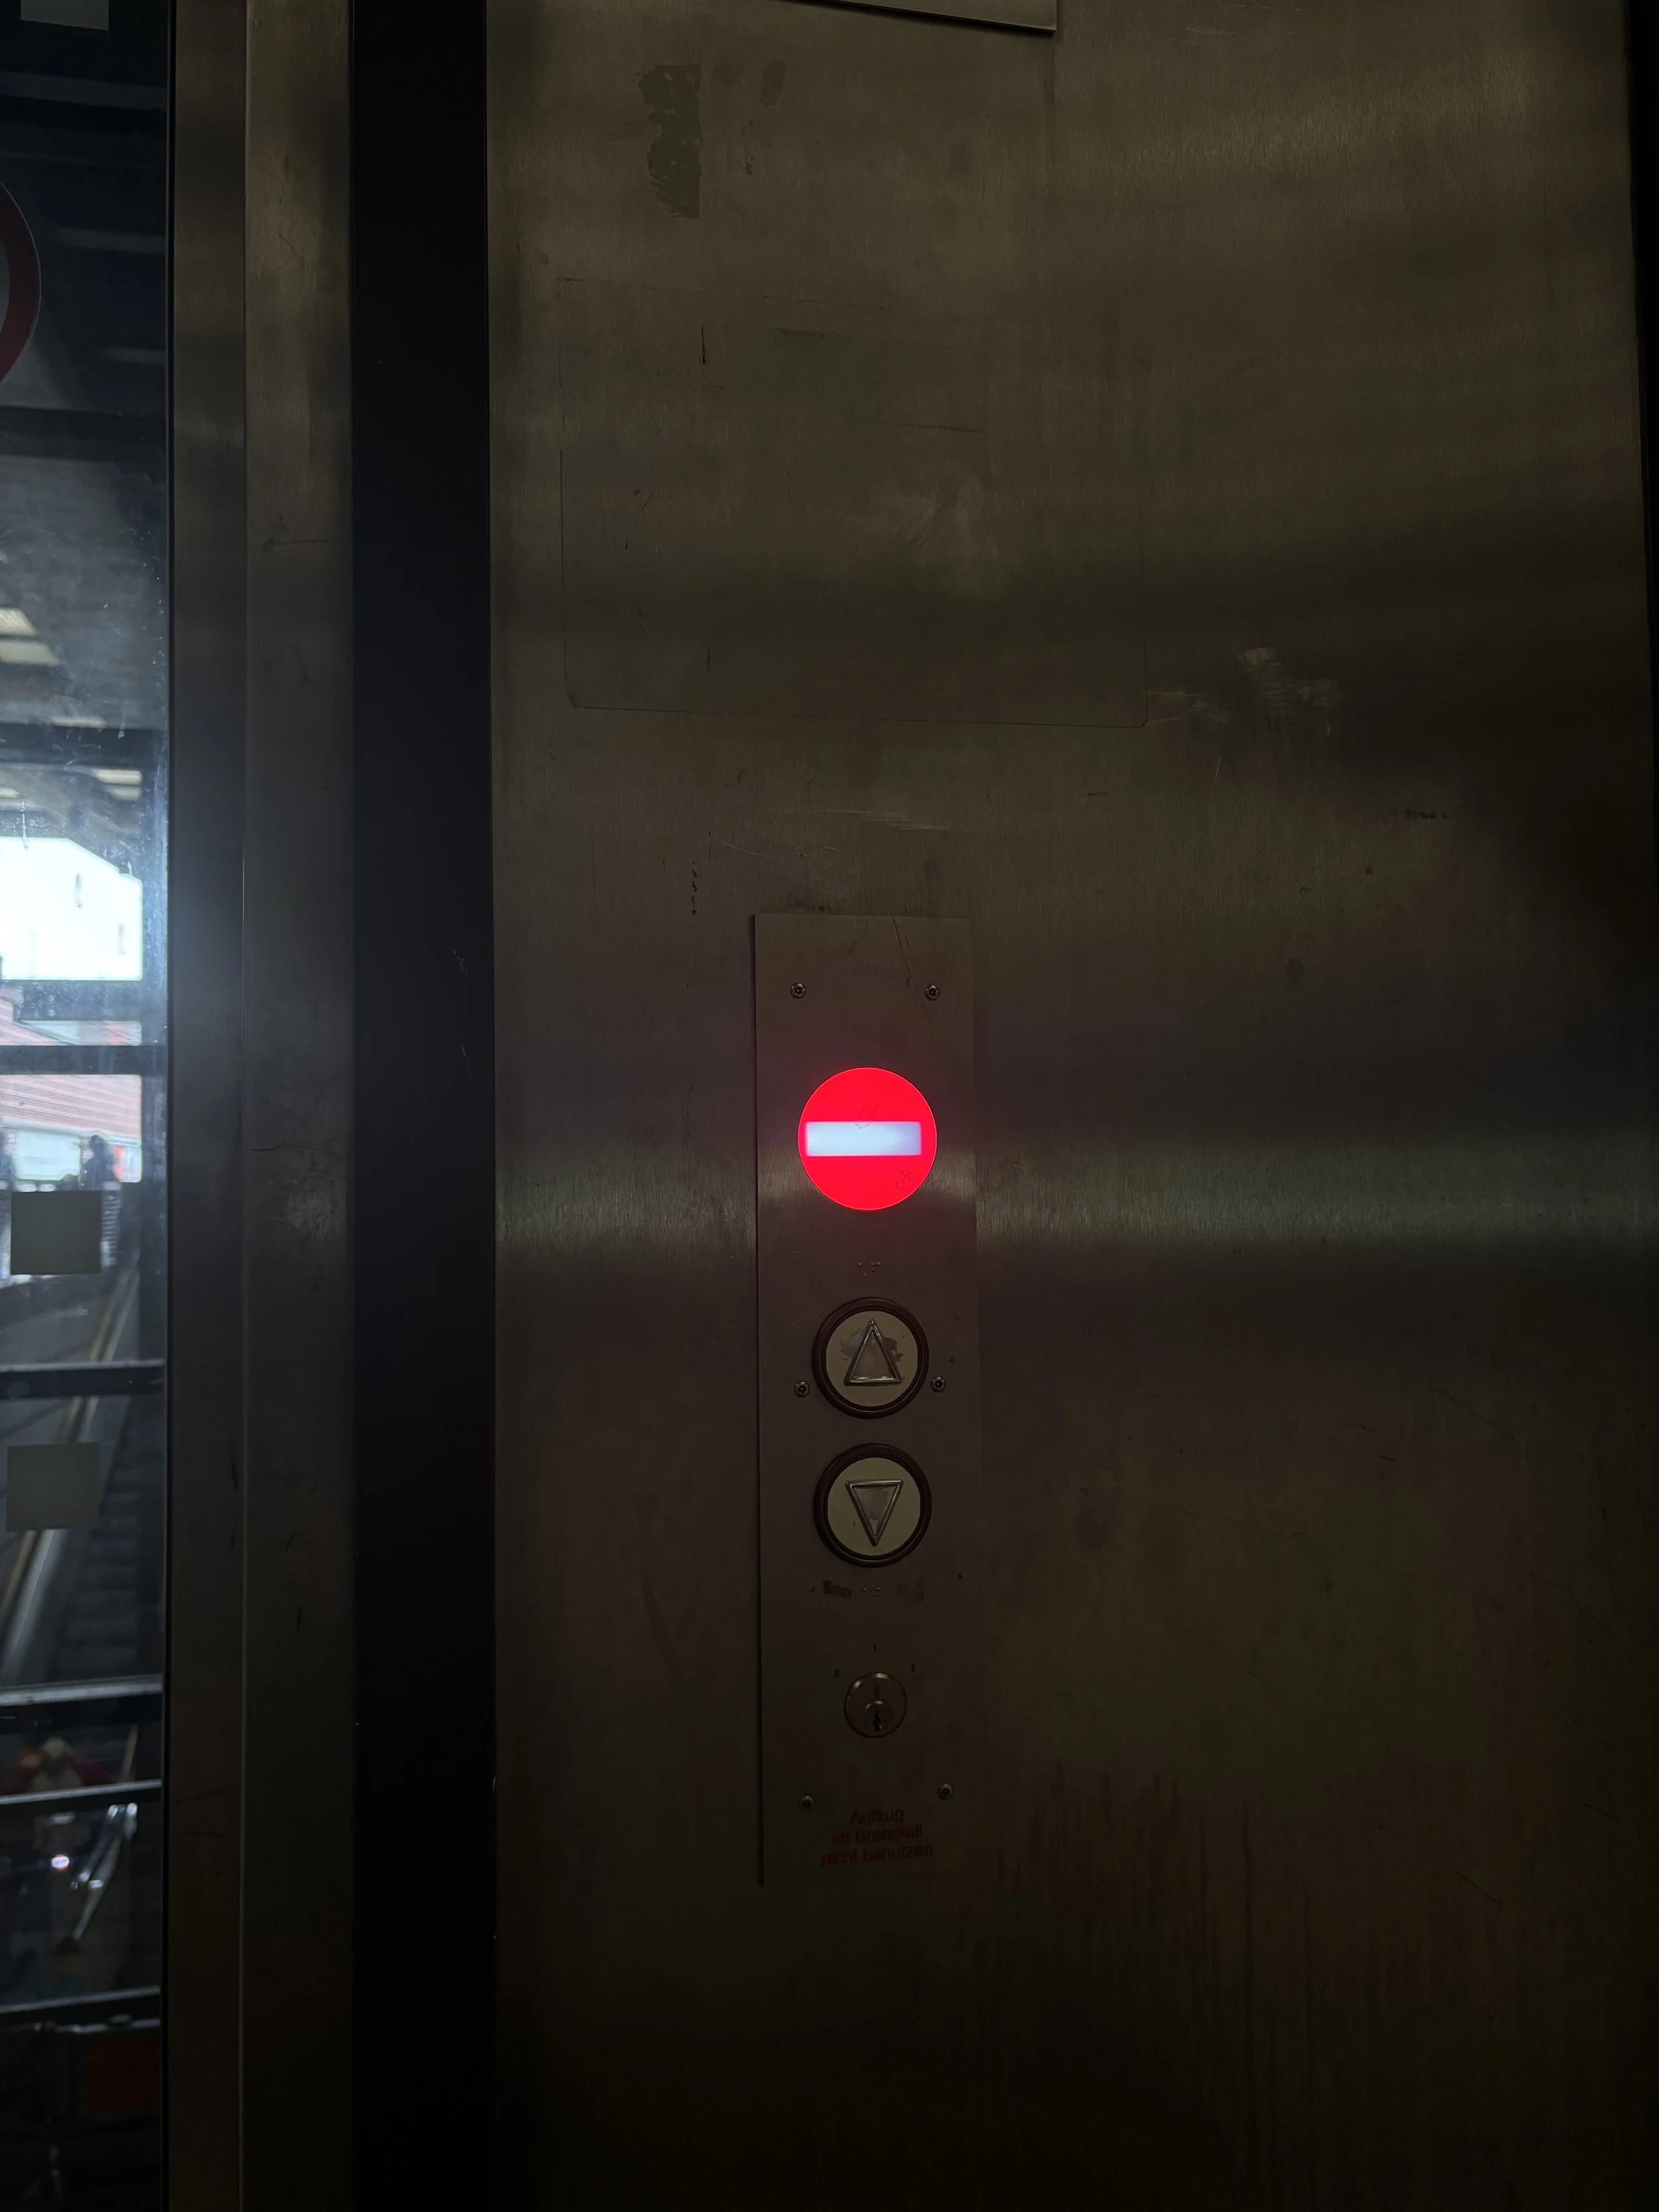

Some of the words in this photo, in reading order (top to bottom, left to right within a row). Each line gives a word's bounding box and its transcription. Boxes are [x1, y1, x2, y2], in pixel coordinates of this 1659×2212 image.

[910, 1662, 916, 1672] 2
[849, 1808, 904, 1824] Aufzug
[855, 1822, 923, 1844] Brandfall
[821, 1848, 858, 1867] nicht
[863, 1844, 934, 1862] benutzen
